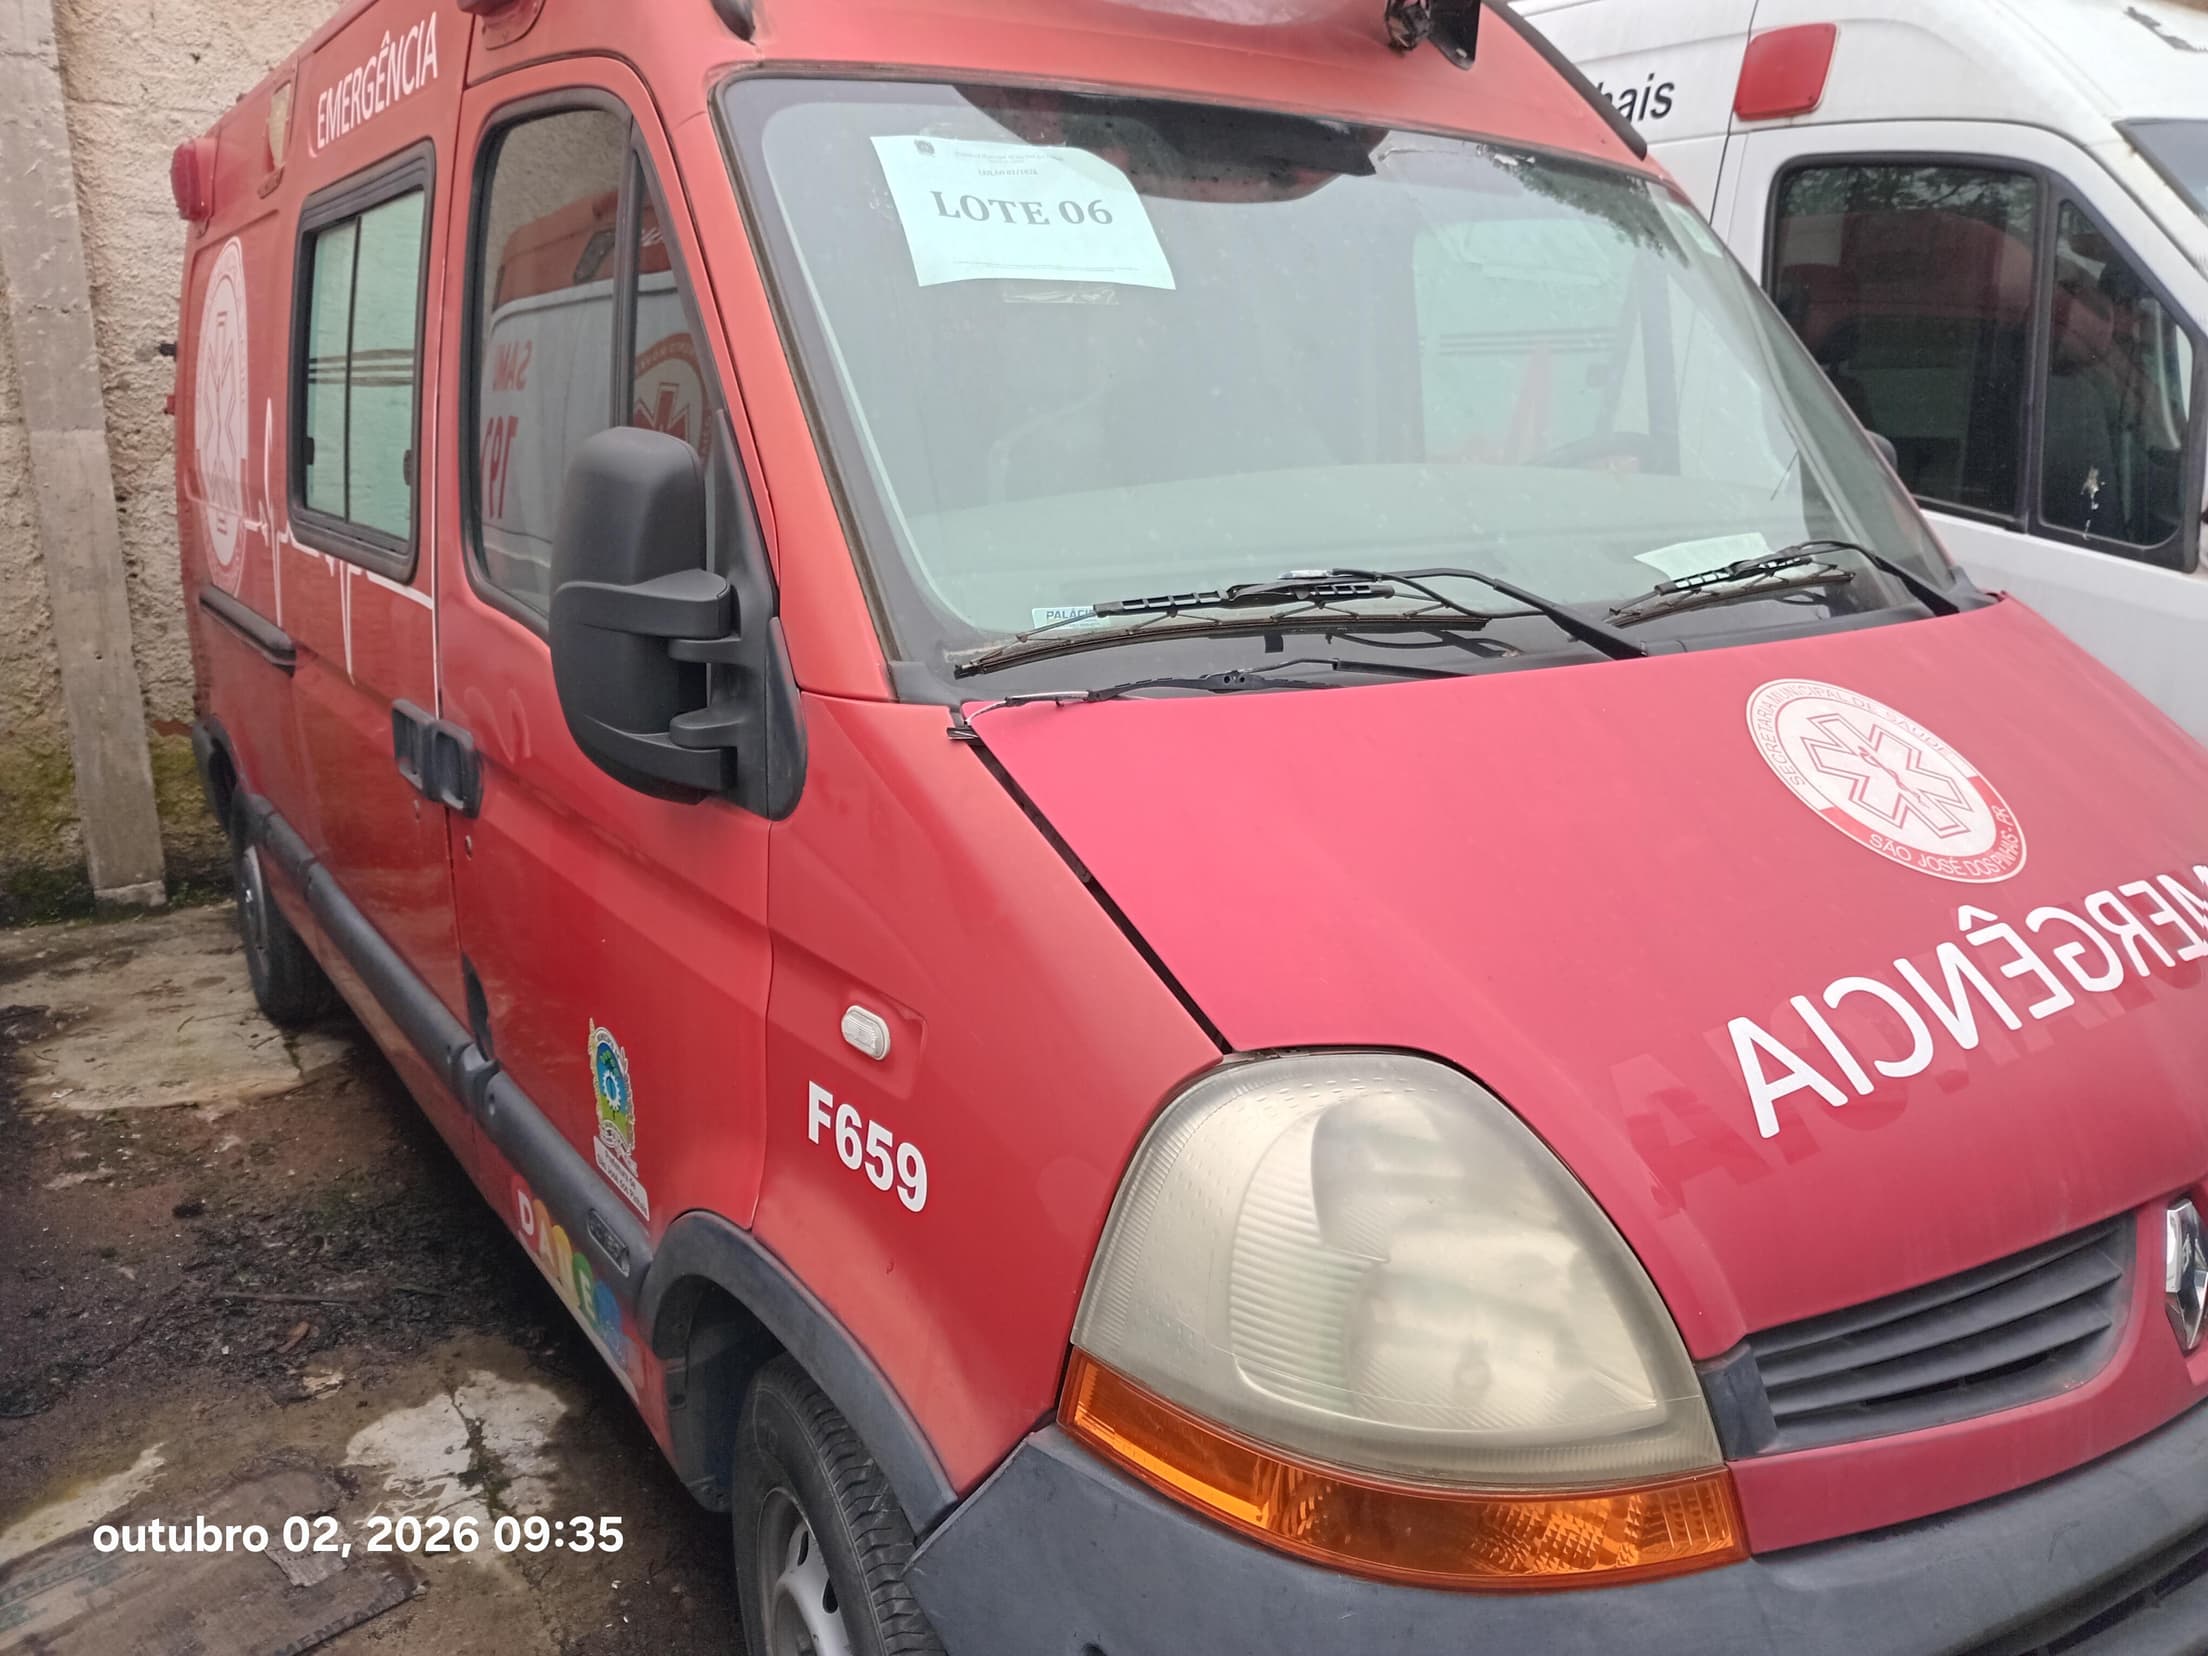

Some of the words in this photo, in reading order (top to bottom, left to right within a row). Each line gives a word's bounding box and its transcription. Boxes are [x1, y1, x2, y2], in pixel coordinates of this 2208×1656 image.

[317, 11, 438, 150] EMERGÊNCIA
[929, 190, 1050, 225] LOTE
[1058, 200, 1113, 225] 06
[1046, 607, 1091, 620] PALÁCI
[1765, 684, 1848, 706] MUNICIPAL
[1756, 700, 1806, 786] SECRETARIA
[1869, 833, 1912, 861] SÃO
[1918, 854, 1968, 876] JOSÉ
[1963, 856, 2000, 876] DOS
[808, 1080, 928, 1212] F659
